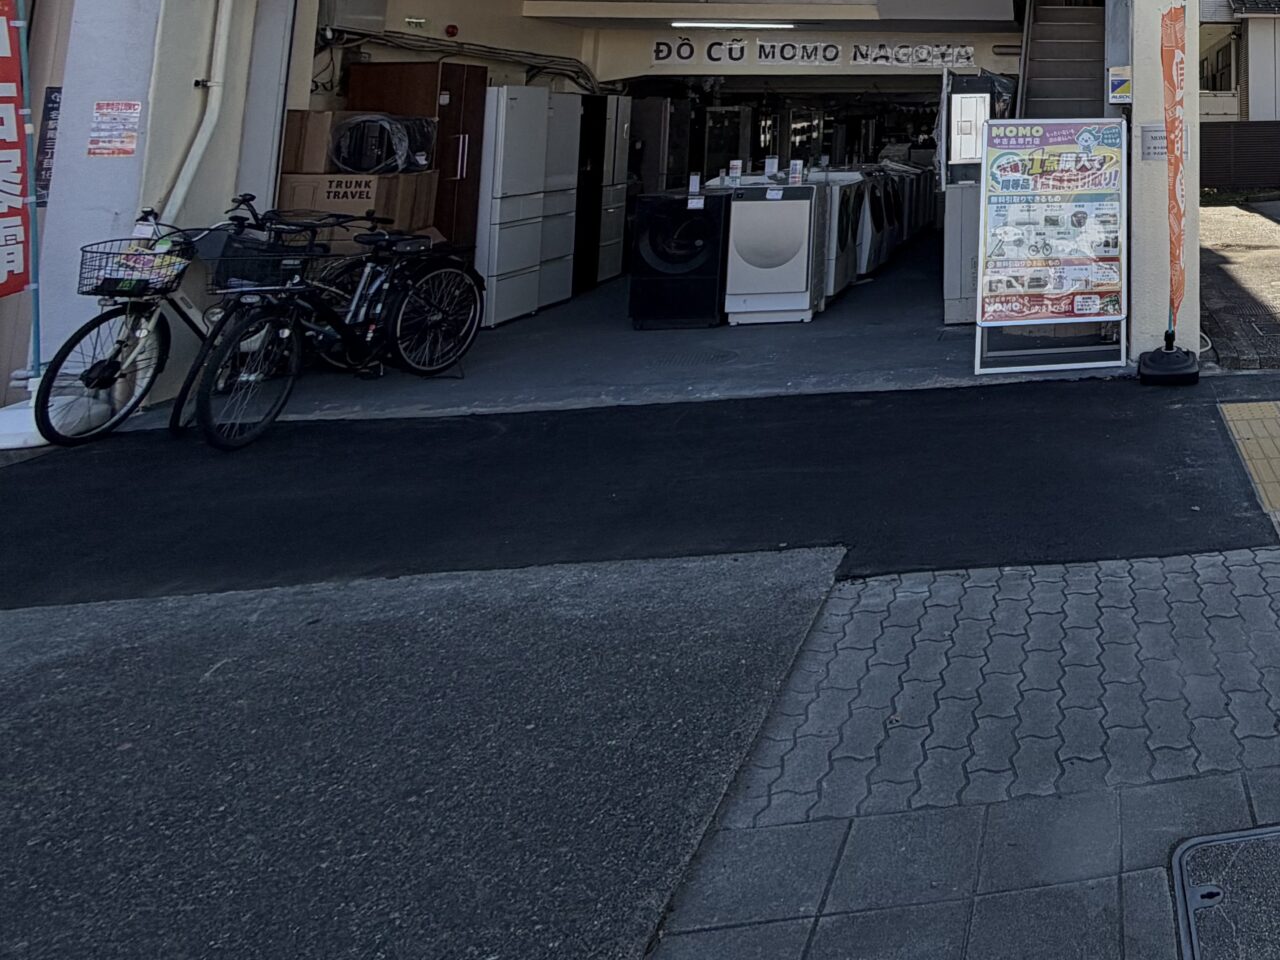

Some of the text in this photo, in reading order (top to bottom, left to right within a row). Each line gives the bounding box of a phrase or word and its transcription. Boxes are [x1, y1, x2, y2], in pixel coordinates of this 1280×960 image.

[758, 42, 840, 62] MOMO
[991, 126, 1043, 138] MOMO
[327, 179, 373, 190] TRUNK
[325, 190, 373, 200] TRAVEL
